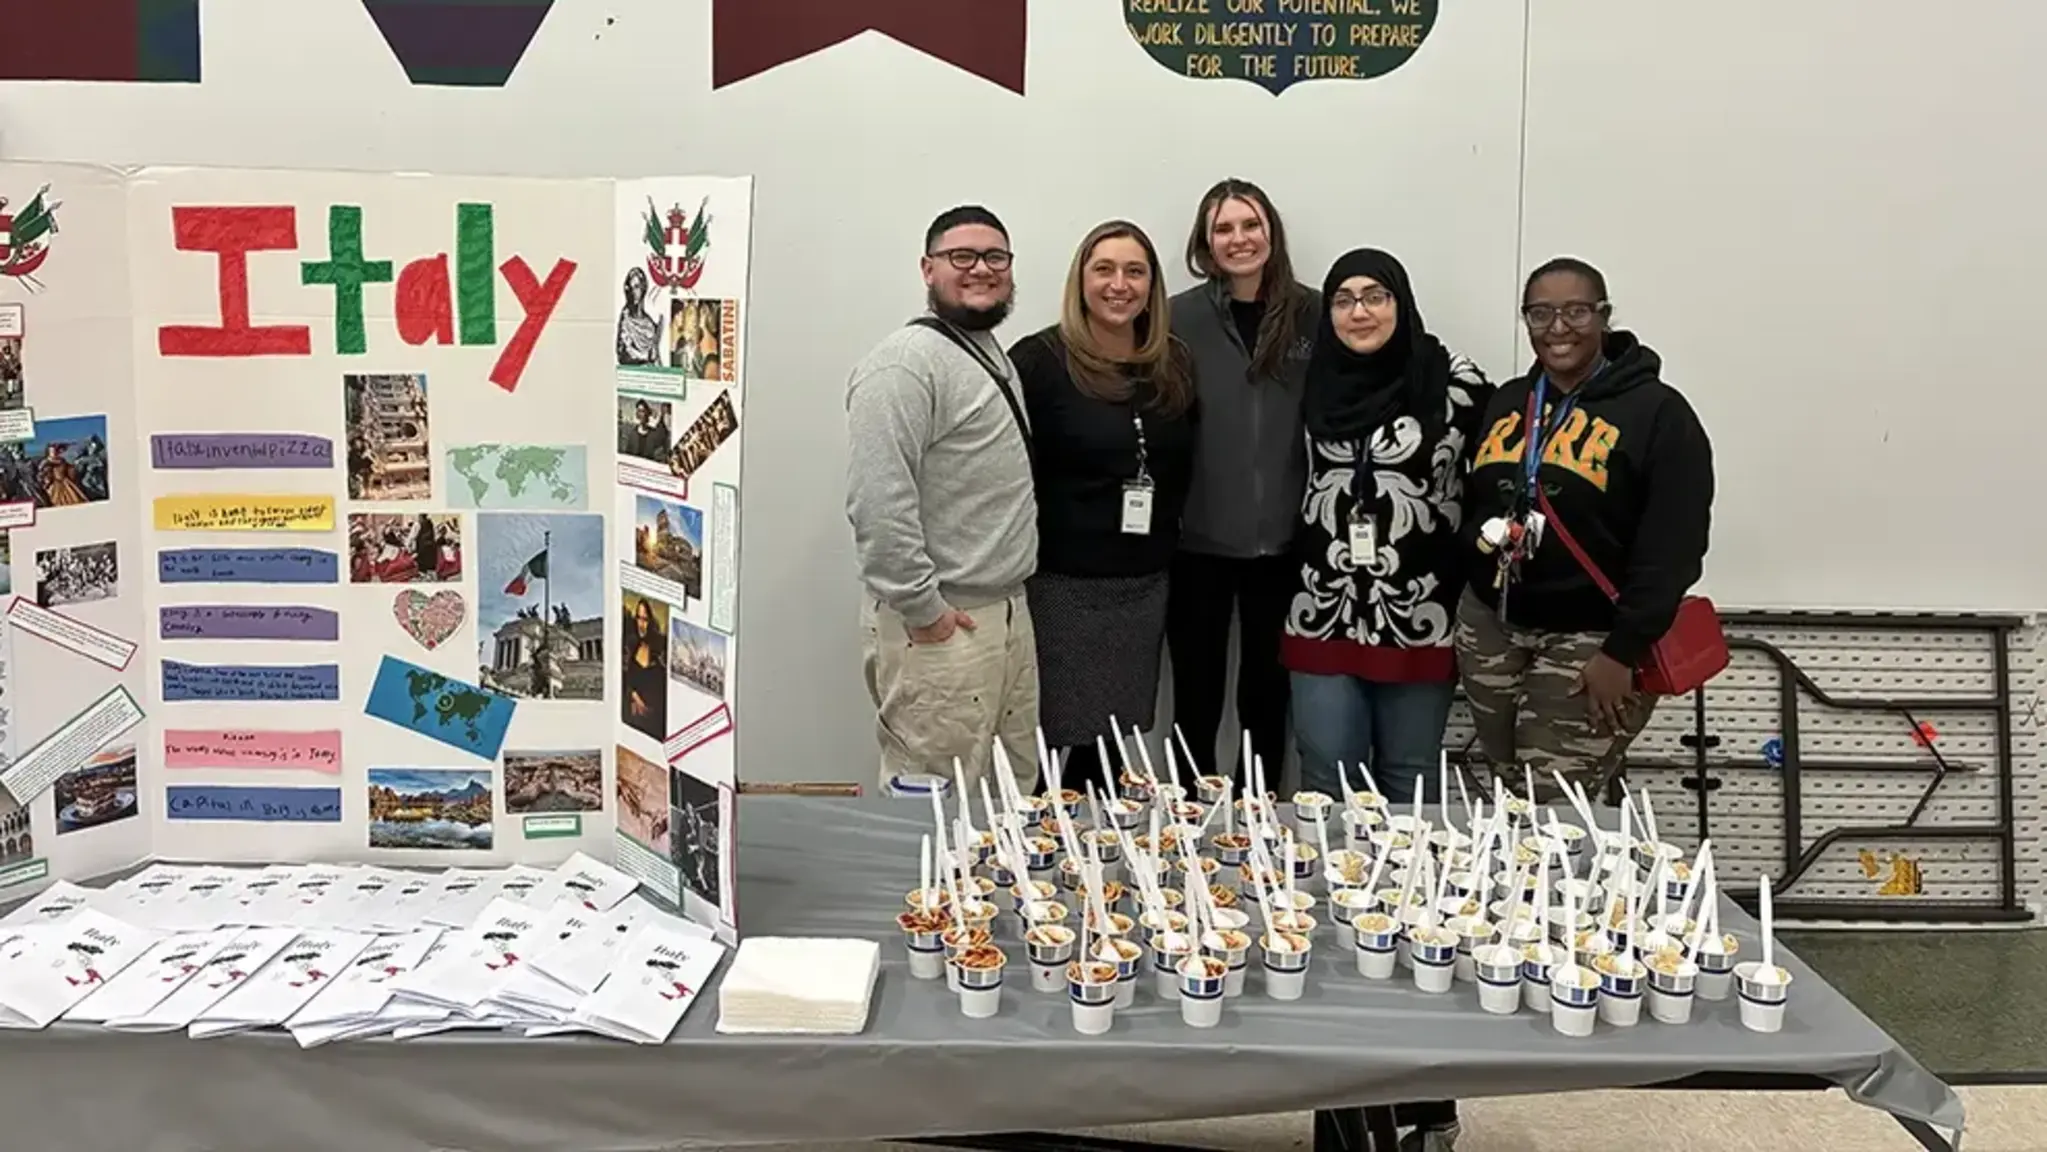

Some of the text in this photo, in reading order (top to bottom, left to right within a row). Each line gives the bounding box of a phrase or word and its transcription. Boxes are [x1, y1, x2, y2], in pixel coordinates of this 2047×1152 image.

[1130, 0, 1209, 13] REALIZE
[1228, 0, 1264, 14] OUR
[1391, 0, 1421, 15] WE
[1128, 23, 1423, 48] WORK DILIGENTLY TO PREPARE
[1186, 54, 1365, 78] FOR THE FUTURE.
[158, 202, 578, 393] Italy
[722, 299, 735, 382] SABATINI
[1473, 402, 1620, 493] RRE
